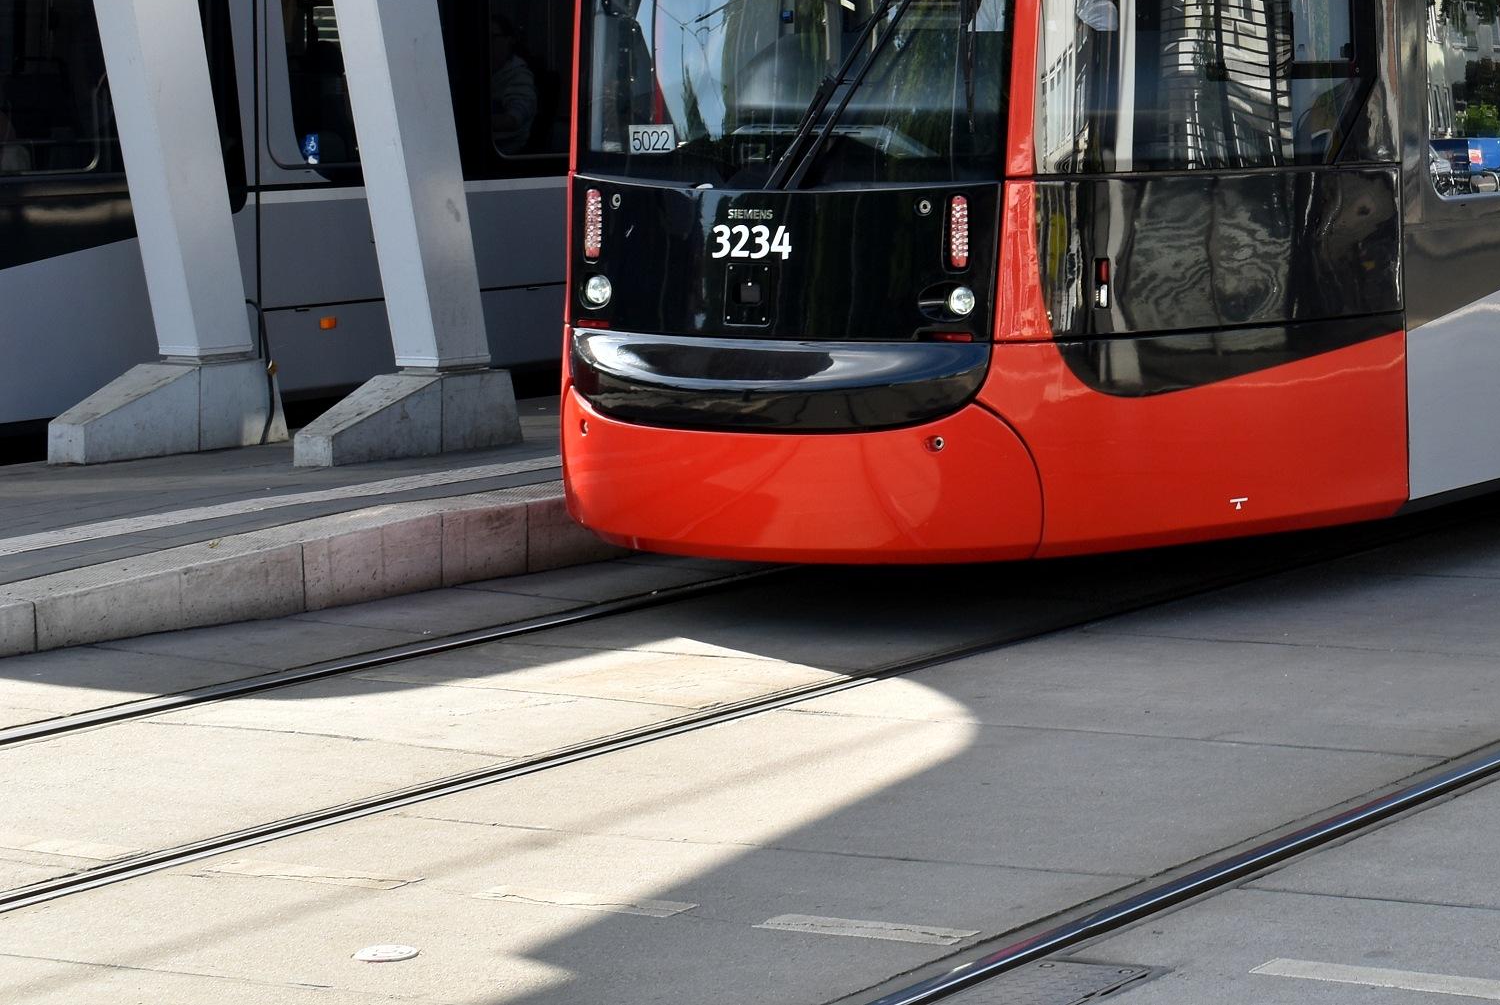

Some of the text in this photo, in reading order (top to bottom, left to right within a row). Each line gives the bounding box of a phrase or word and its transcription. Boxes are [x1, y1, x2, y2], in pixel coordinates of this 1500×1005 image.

[632, 130, 671, 151] 5022
[727, 208, 774, 220] SIEMENS
[711, 224, 792, 260] 3234
